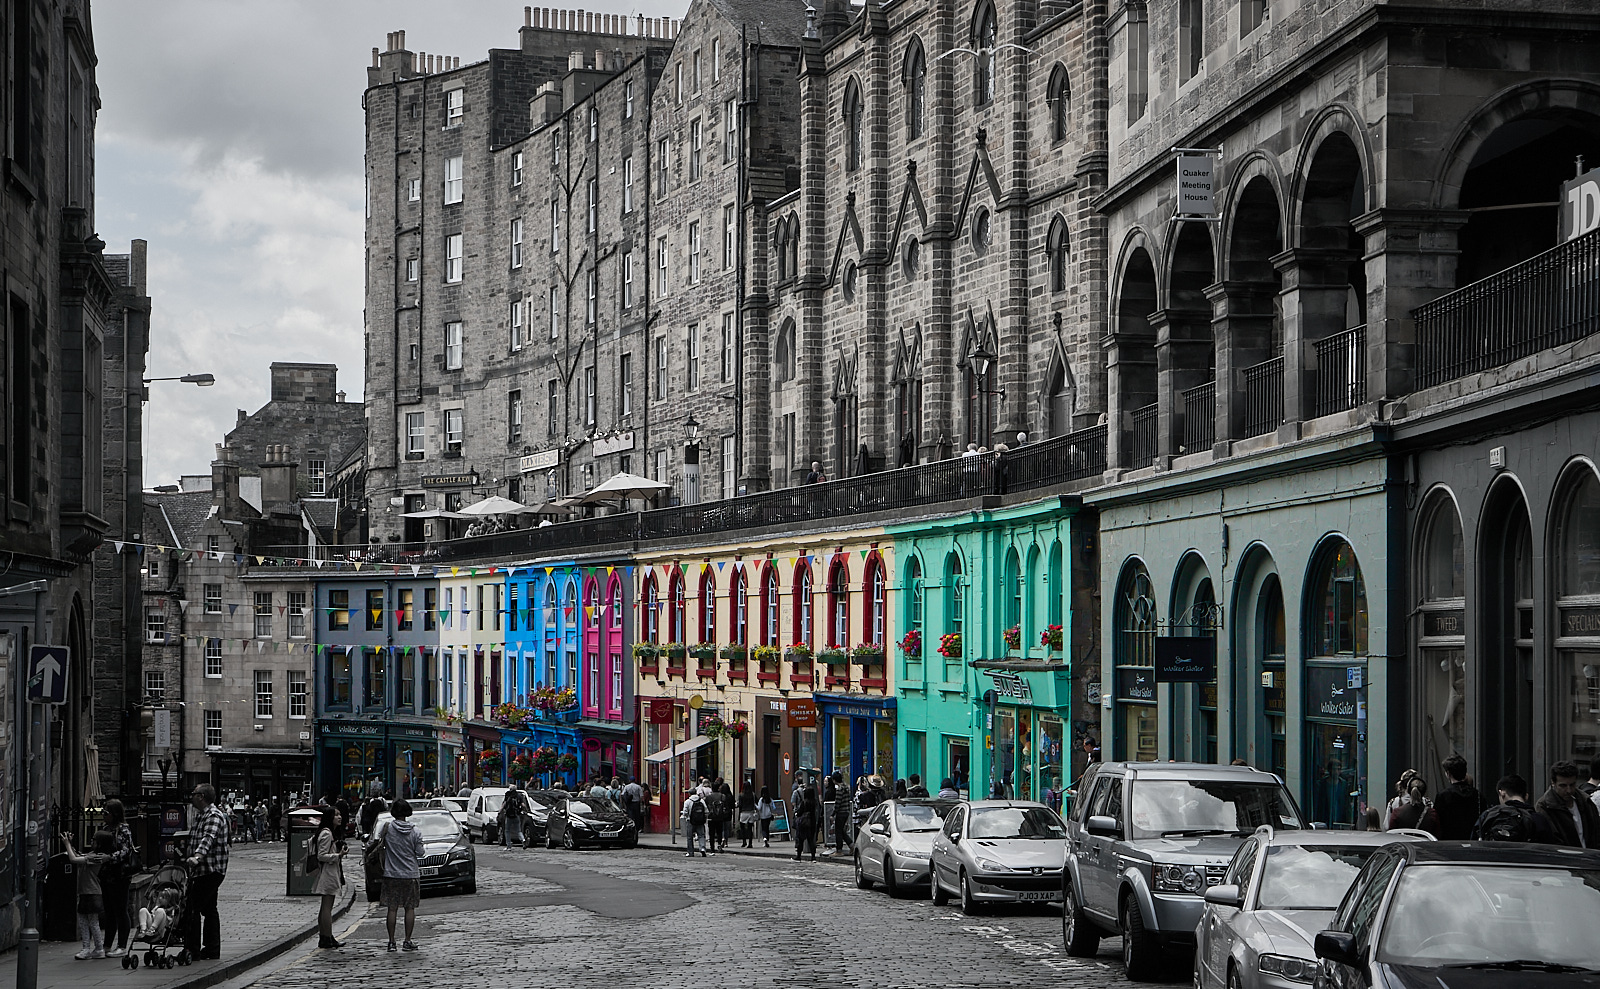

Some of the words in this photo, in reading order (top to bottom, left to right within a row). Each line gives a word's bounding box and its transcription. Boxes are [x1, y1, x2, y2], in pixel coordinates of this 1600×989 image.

[1182, 182, 1210, 190] Meeting
[1320, 701, 1338, 713] Walker
[1339, 701, 1354, 714] Slater
[166, 812, 179, 820] LOST
[165, 844, 175, 852] LOS
